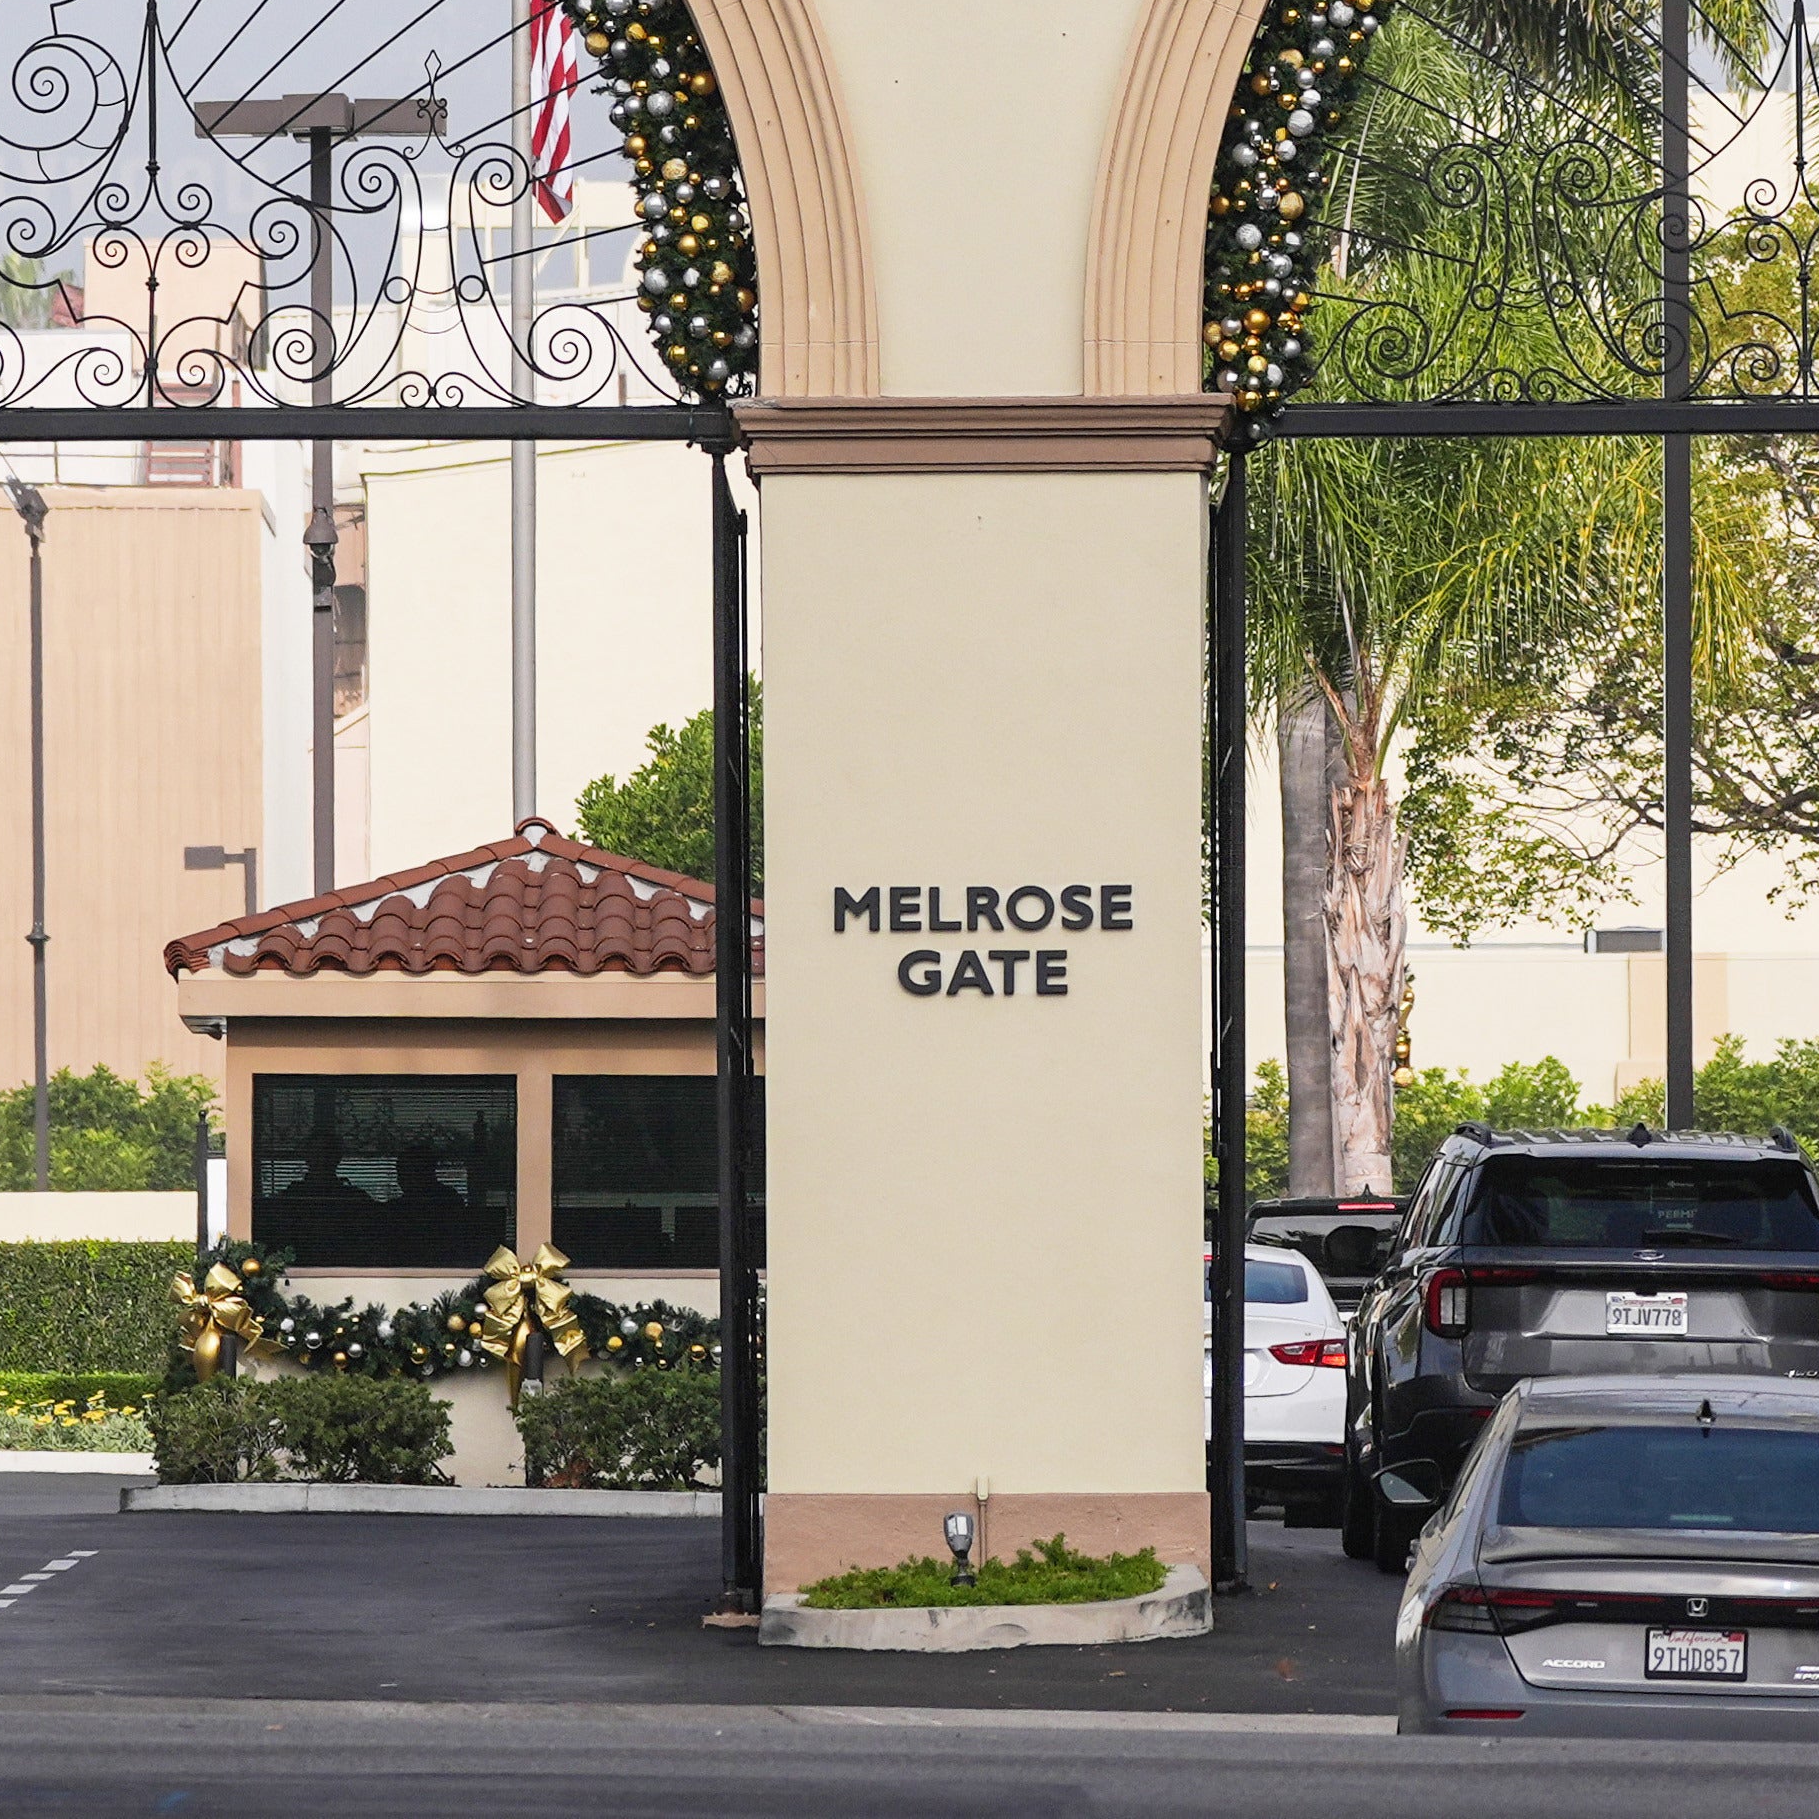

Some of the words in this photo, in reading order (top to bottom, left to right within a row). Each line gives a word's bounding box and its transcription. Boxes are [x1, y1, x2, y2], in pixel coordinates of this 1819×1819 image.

[833, 884, 1133, 932] MELROSE
[897, 949, 1068, 996] GATE
[1612, 1307, 1682, 1326] 9TJV778
[1542, 1659, 1606, 1669] ACCORD
[1652, 1647, 1741, 1673] 9THD857
